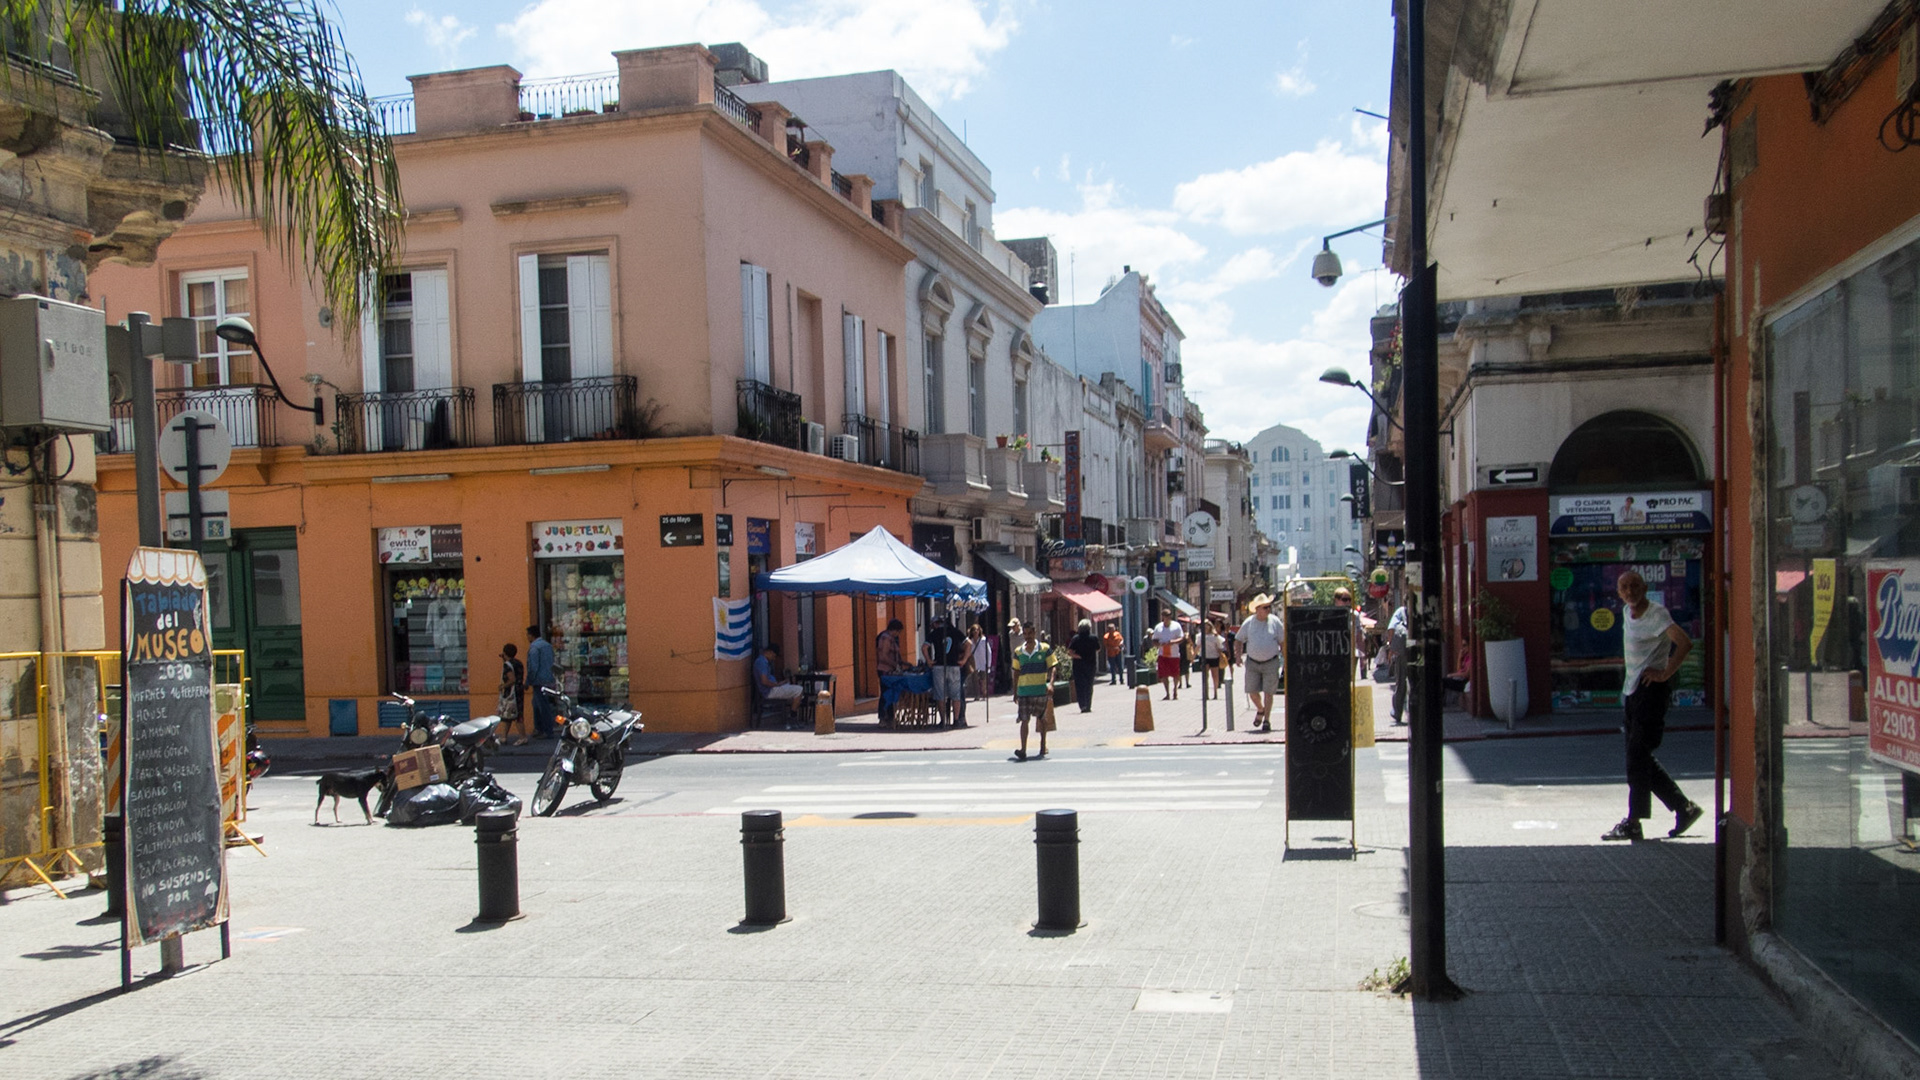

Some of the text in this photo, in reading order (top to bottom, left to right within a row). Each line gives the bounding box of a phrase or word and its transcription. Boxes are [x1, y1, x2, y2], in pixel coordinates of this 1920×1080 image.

[1355, 479, 1366, 517] HOTEL
[1659, 497, 1695, 506] PRO PAC
[677, 516, 691, 524] Mayo
[545, 525, 613, 537] JUGUETERIA
[389, 539, 418, 548] ewtto
[136, 590, 198, 615] Tablado
[157, 611, 178, 630] del
[135, 628, 204, 661] MUSEO
[136, 707, 167, 722] HOUSE
[1882, 709, 1916, 741] 2903
[1886, 743, 1902, 759] SAN
[173, 781, 182, 793] 17
[141, 868, 212, 899] NO SUSPENDE
[167, 889, 190, 907] POR
